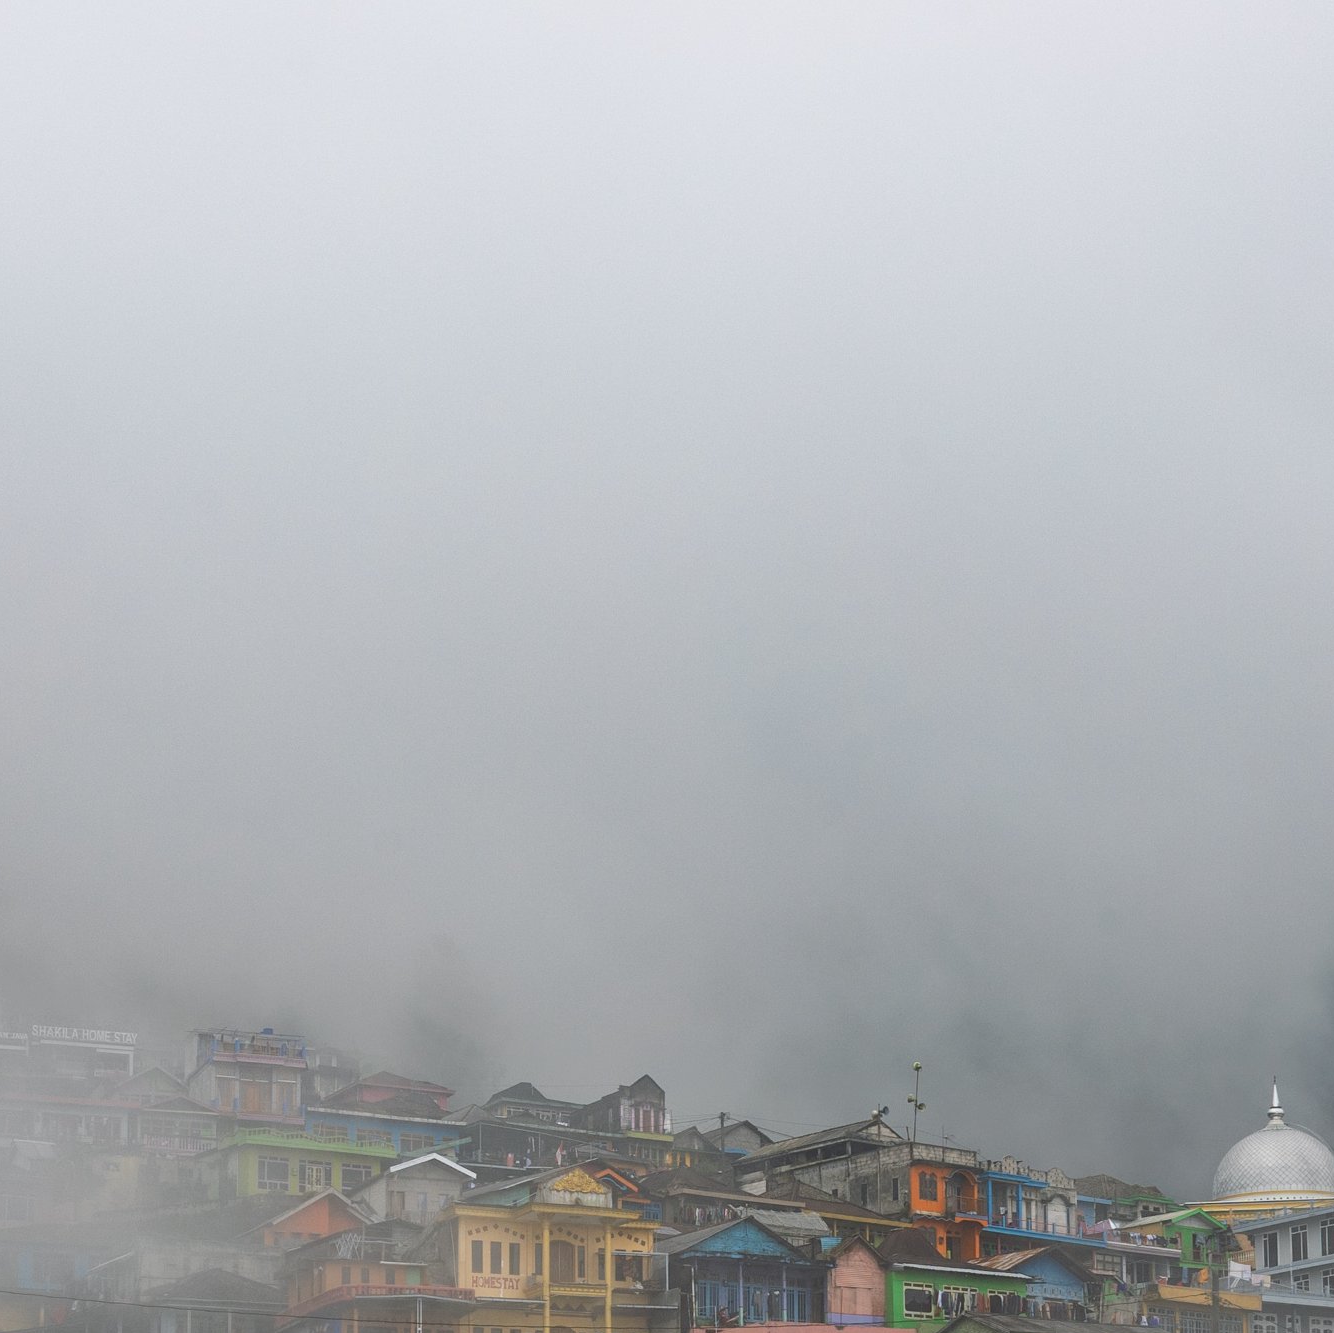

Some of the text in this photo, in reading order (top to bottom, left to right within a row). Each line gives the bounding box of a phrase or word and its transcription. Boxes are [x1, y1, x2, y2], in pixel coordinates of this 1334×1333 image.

[31, 1024, 138, 1045] SHAKILA HOME STAY
[471, 1275, 520, 1290] HOMESTAY
